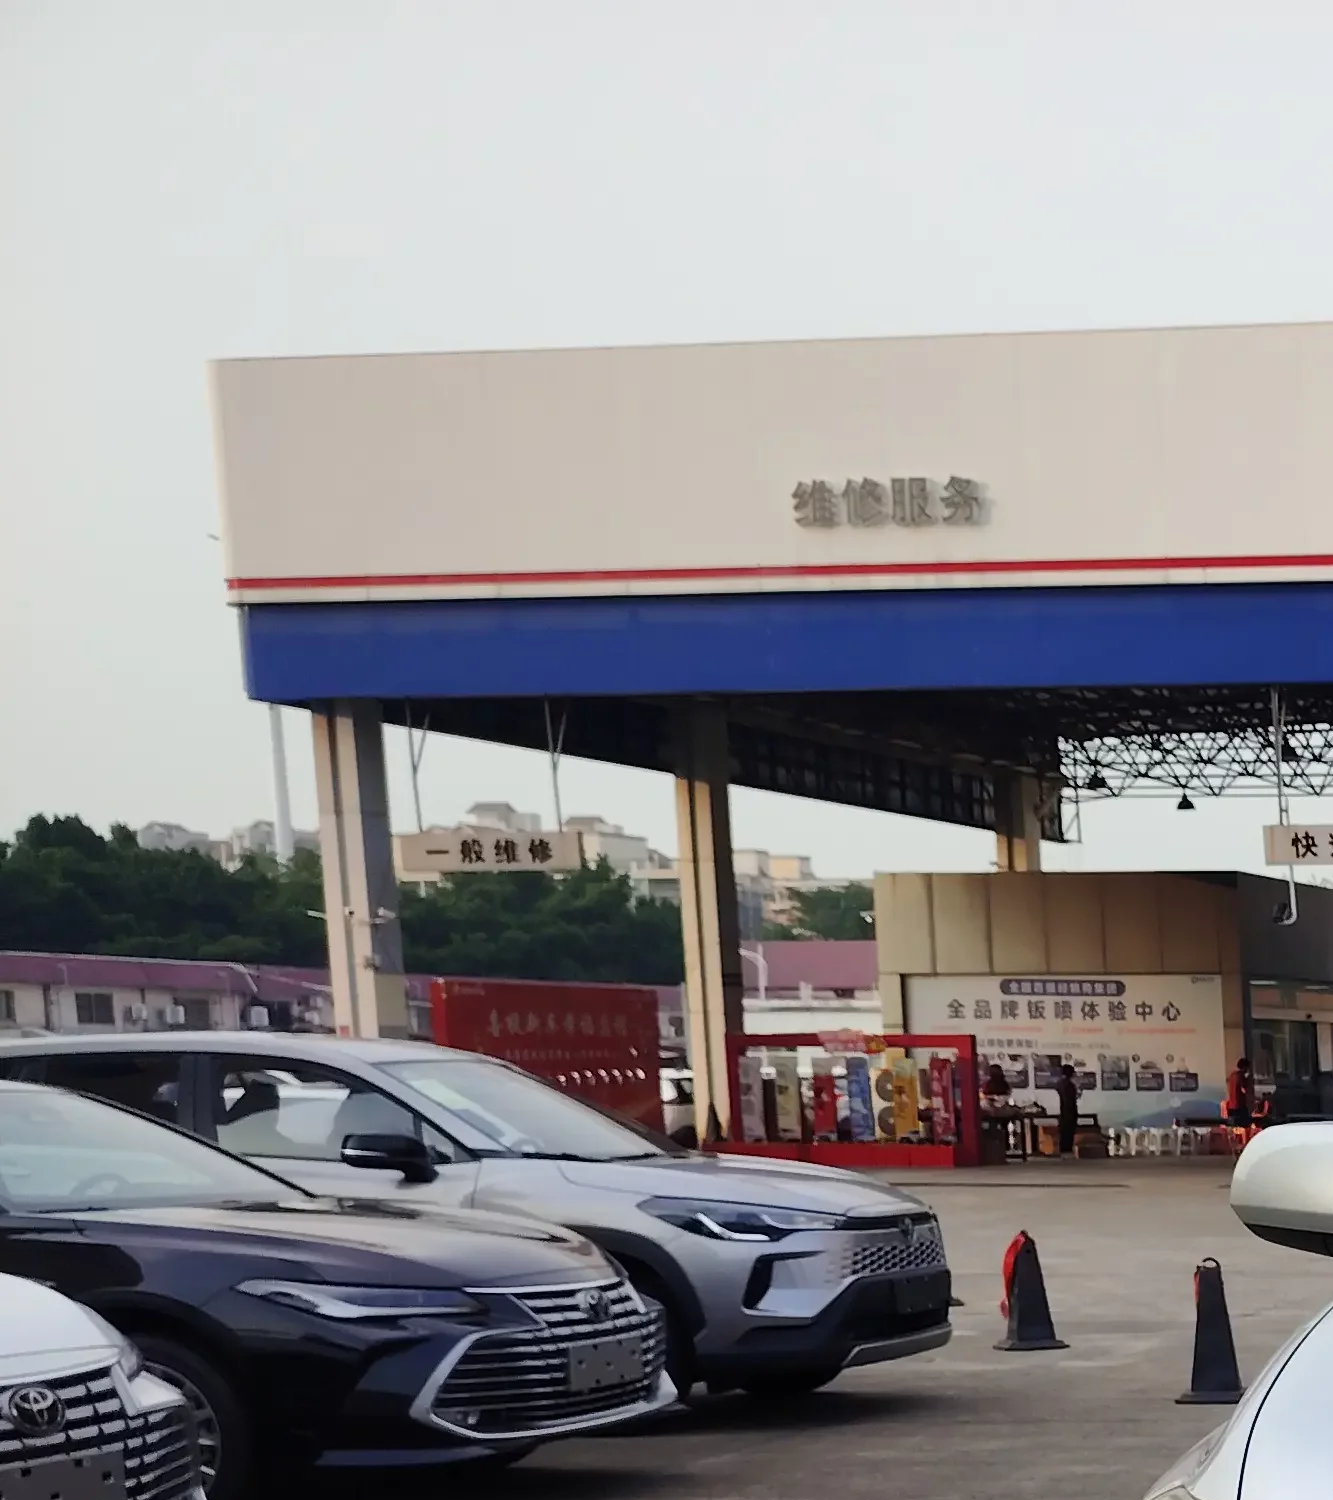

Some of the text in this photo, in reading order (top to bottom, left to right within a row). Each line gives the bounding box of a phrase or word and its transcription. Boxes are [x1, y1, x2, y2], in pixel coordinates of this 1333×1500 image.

[791, 475, 984, 527] 维修服务
[425, 837, 553, 864] 一般维修
